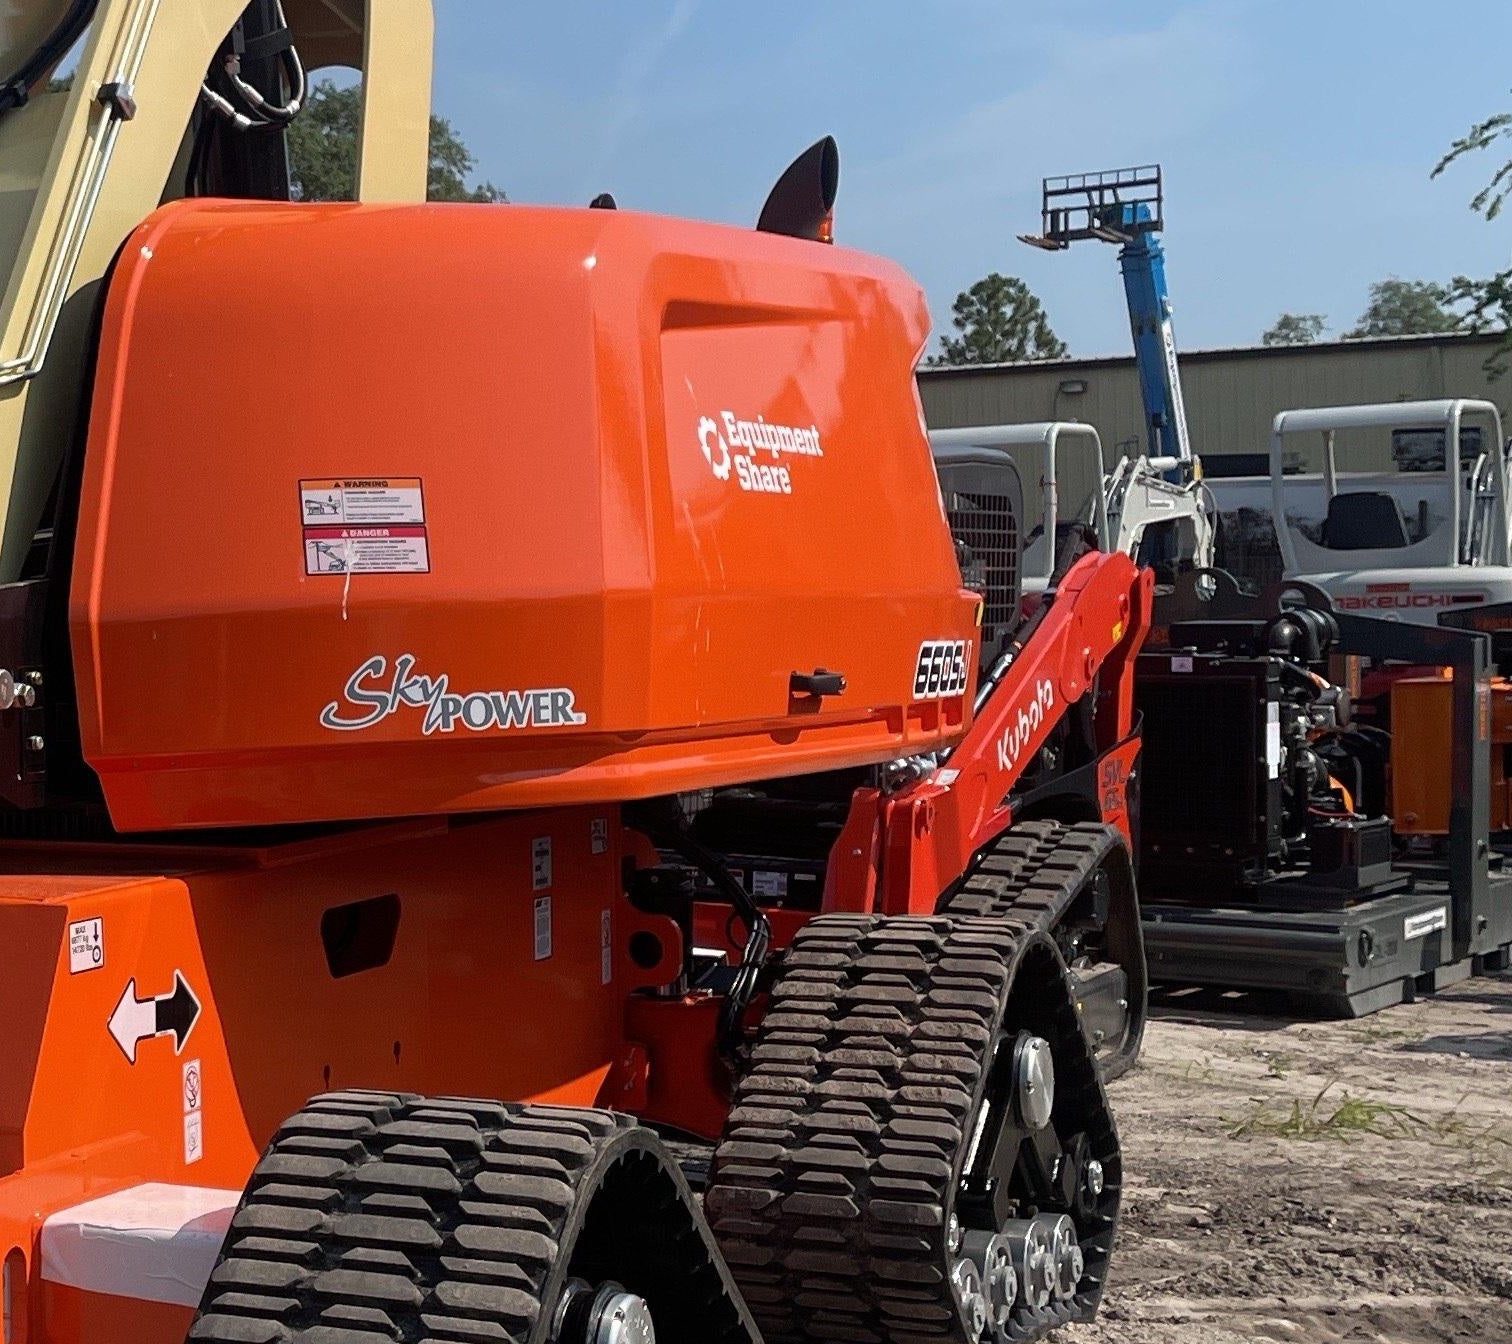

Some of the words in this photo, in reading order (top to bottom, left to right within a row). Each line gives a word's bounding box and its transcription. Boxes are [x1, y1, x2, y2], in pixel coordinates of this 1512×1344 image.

[719, 410, 824, 458] Equipment
[343, 480, 389, 488] WARNING
[734, 453, 792, 494] Share
[349, 529, 390, 537] DANGER
[996, 679, 1054, 772] Kubota
